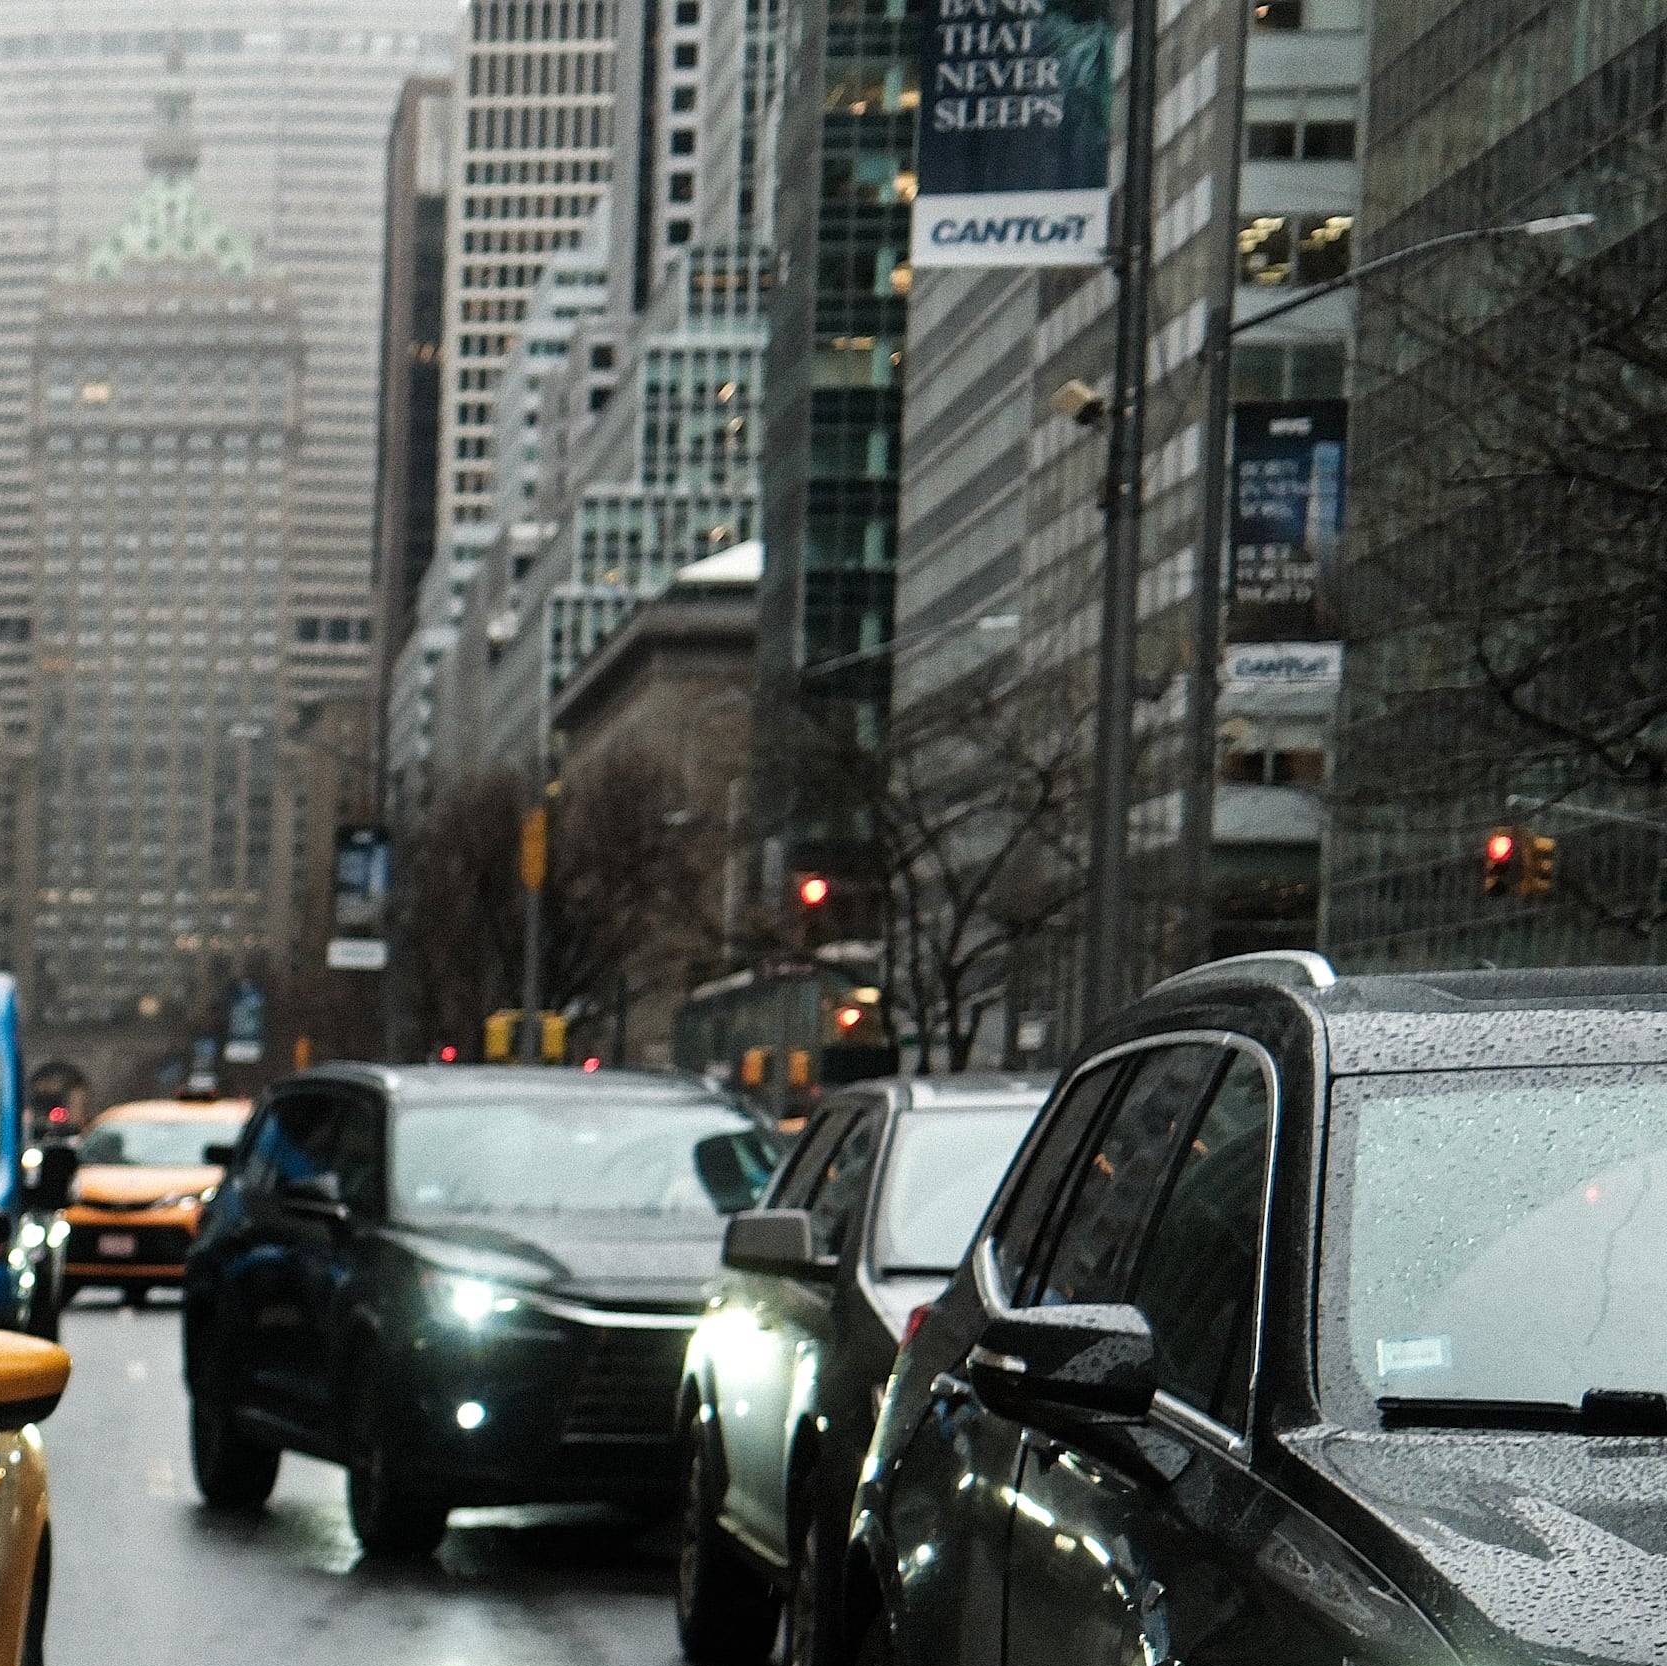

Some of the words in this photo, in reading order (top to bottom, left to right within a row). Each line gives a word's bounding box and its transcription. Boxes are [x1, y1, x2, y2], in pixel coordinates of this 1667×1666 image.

[938, 20, 1035, 54] THAT
[935, 58, 1060, 92] NEVER
[934, 94, 1063, 132] SLEEPS
